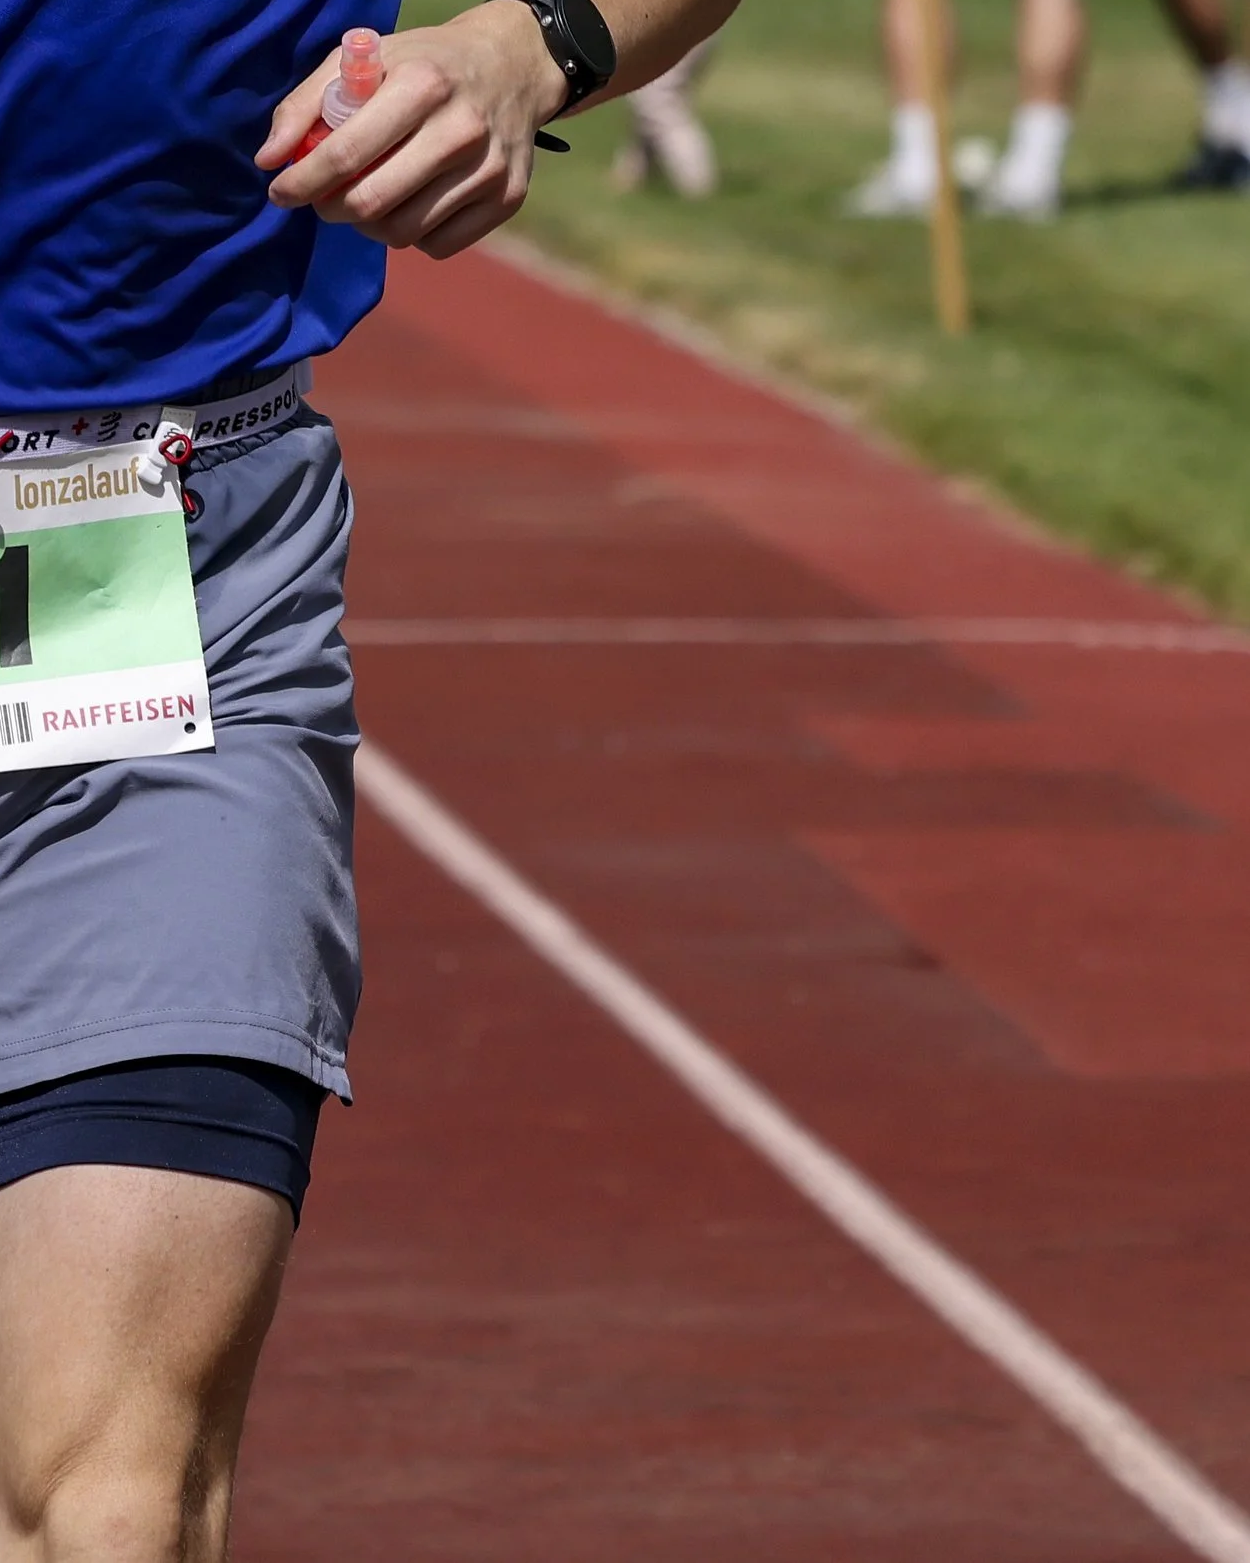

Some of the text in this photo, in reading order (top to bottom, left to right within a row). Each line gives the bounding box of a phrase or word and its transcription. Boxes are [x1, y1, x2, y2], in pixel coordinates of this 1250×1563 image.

[133, 382, 297, 441] CPRESSPO
[14, 456, 140, 511] lonzalauf
[42, 694, 195, 732] RAIFFEISEN
